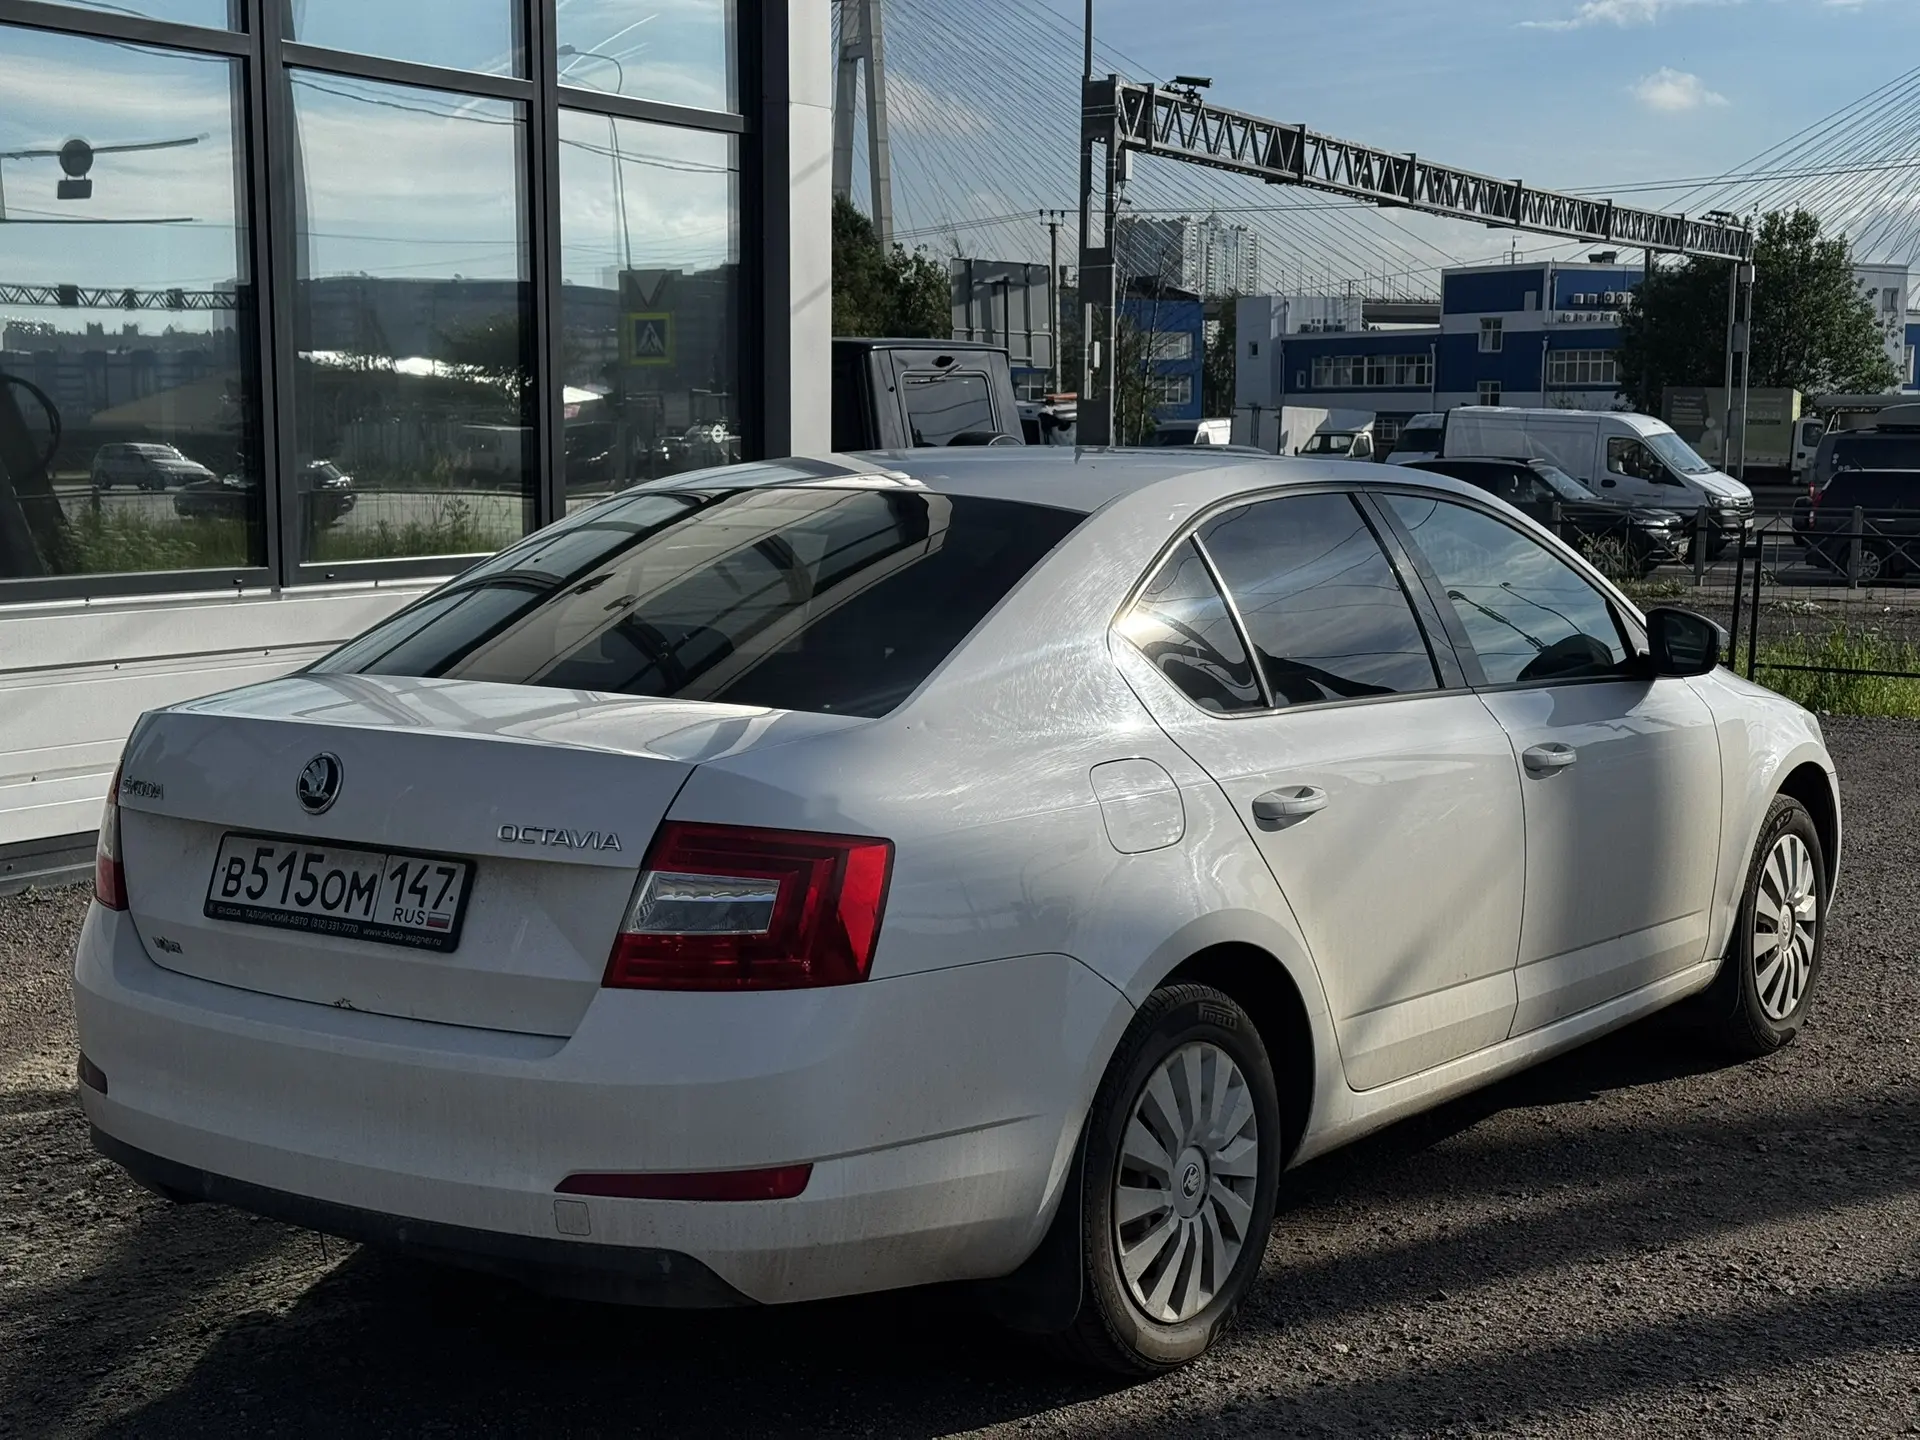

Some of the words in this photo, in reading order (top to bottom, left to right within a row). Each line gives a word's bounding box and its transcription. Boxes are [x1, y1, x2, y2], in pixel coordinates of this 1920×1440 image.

[497, 823, 622, 852] OCTAVIA
[221, 847, 378, 917] В515ОМ
[389, 861, 457, 910] 147
[392, 907, 426, 926] RUS
[362, 927, 442, 946] www.skoda-wagner.ru
[1197, 1002, 1238, 1031] PIRELLI
